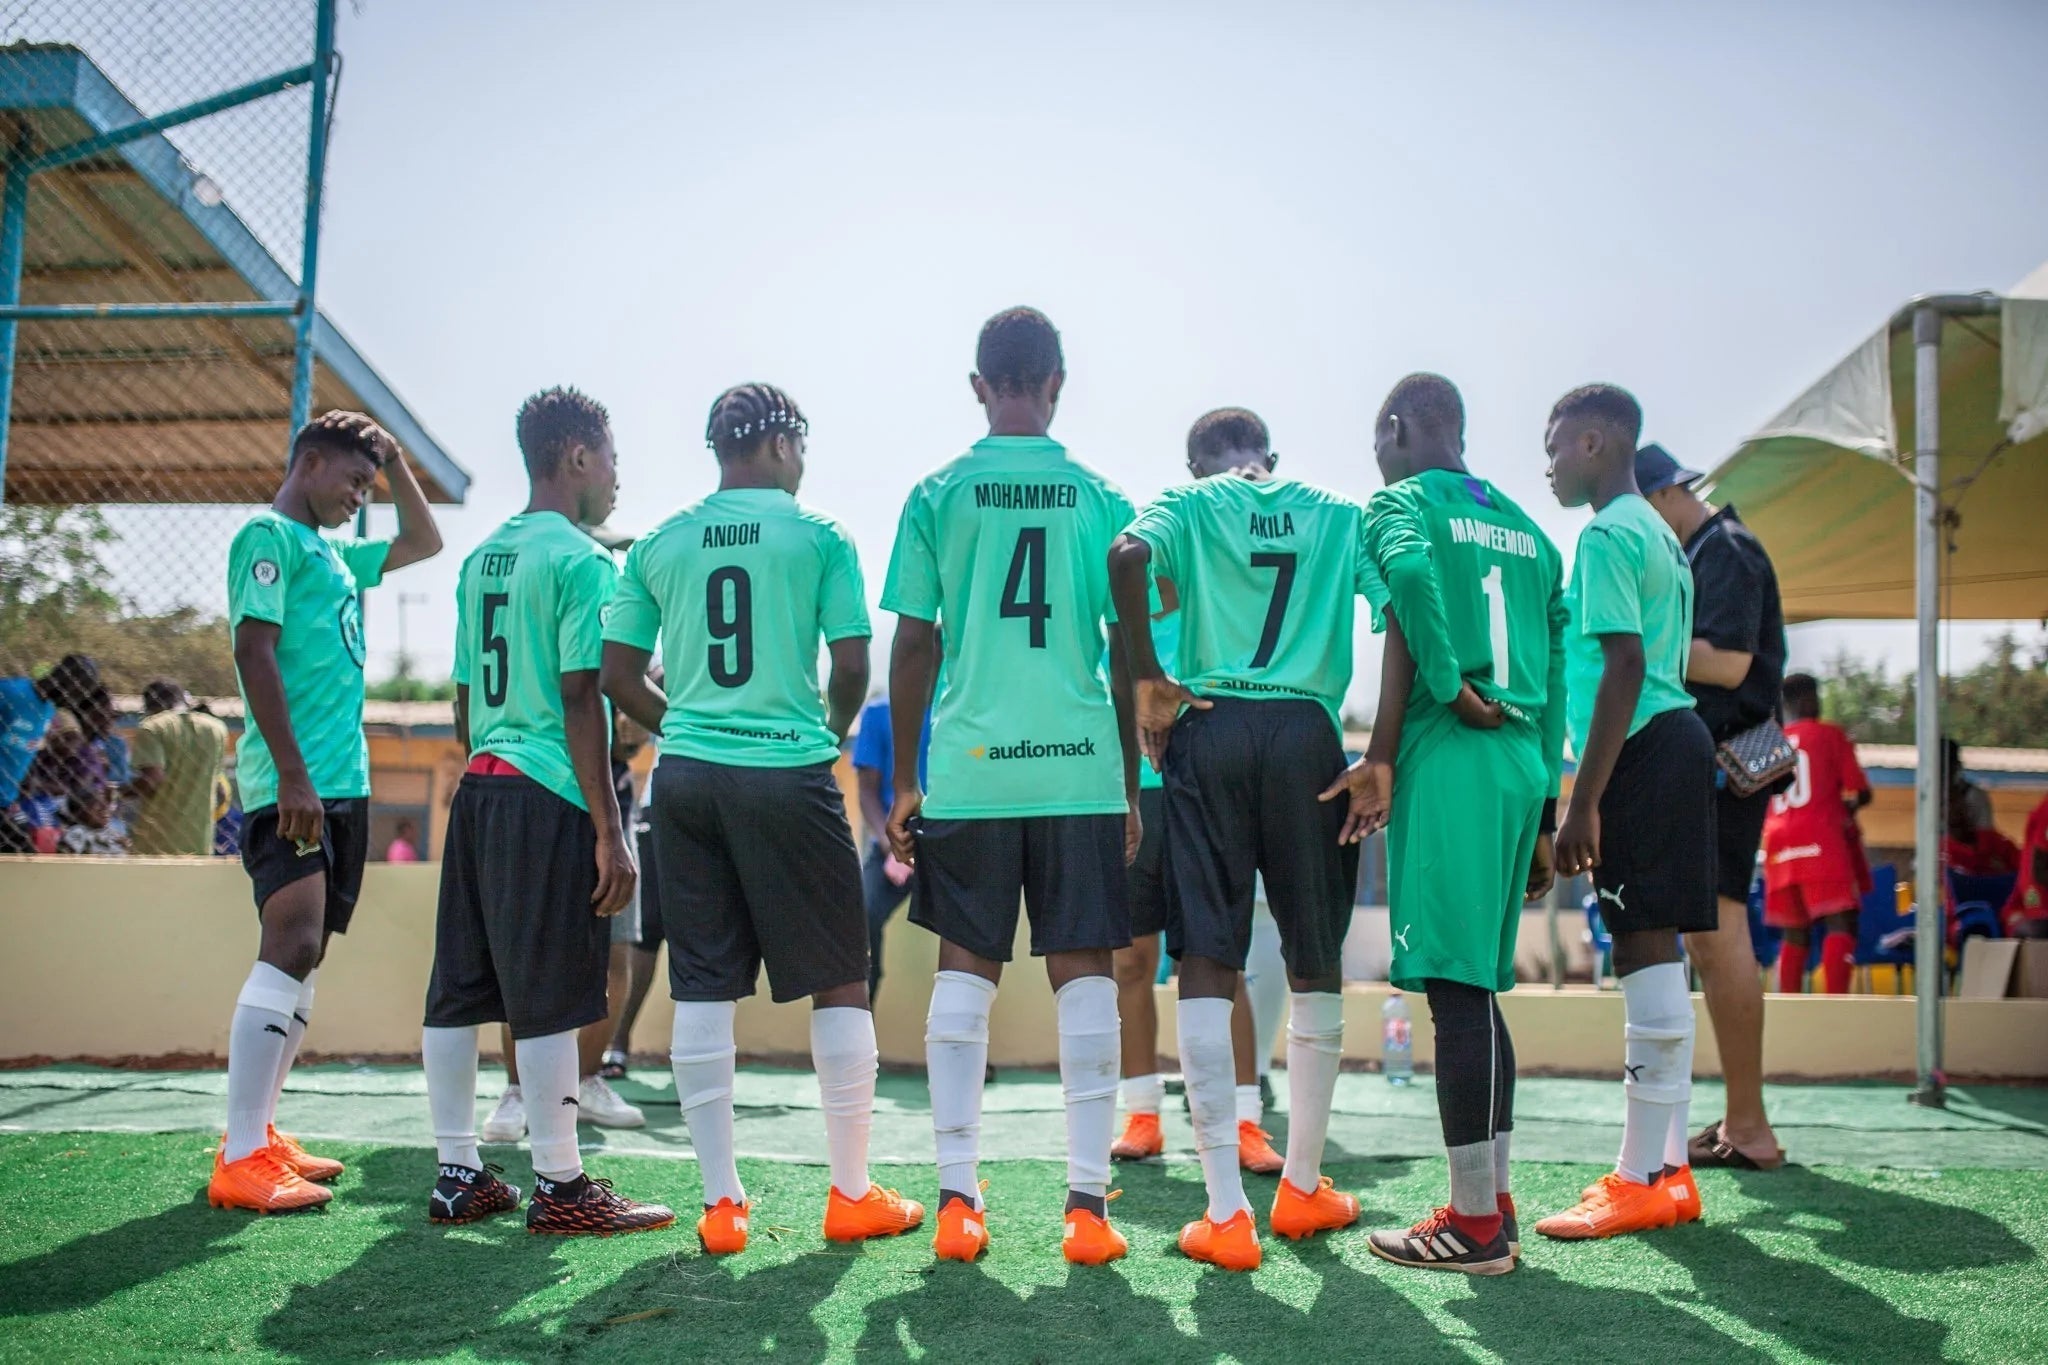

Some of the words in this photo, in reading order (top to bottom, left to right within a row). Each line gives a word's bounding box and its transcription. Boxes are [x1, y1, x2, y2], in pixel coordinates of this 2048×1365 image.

[702, 522, 761, 548] ANDOH
[975, 483, 1077, 509] MOHAMMED
[1249, 512, 1295, 539] AKILA
[706, 565, 754, 688] 9
[1000, 527, 1052, 649] 4
[1248, 552, 1297, 669] 7
[1481, 565, 1509, 689] 1
[483, 593, 509, 707] 5
[988, 737, 1096, 761] audiomack
